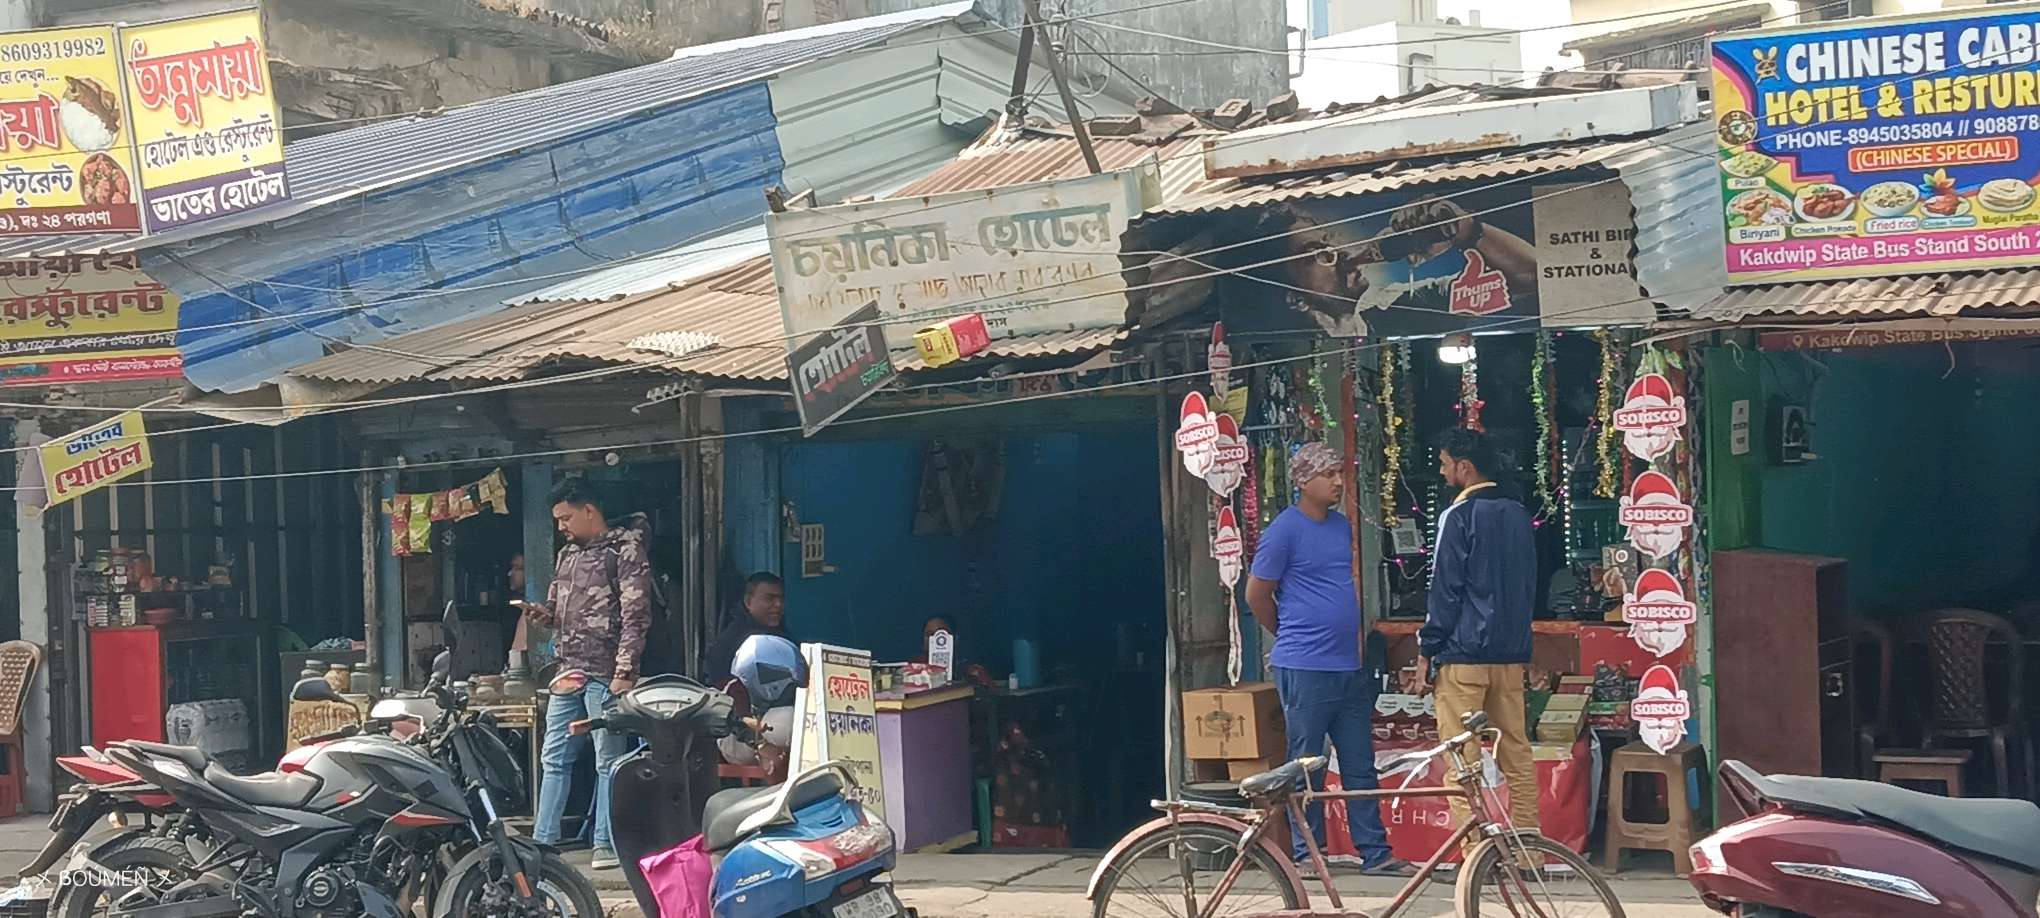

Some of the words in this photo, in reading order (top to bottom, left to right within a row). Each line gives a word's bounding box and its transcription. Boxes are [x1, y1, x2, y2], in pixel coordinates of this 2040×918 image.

[1, 37, 105, 62] 8609319982
[1786, 31, 1946, 83] CHINESE
[1765, 84, 1868, 126] HOTEL
[1877, 82, 1904, 118] &
[1913, 70, 2040, 115] RESTUR
[1776, 121, 1953, 149] PHONE-8945035804
[1974, 115, 2040, 134] 908878
[144, 133, 190, 169] হোটেল
[1856, 145, 1932, 170] (CHINESE
[1936, 140, 2011, 163] SPECIAL)
[151, 185, 216, 223] ভাতের
[220, 170, 286, 210] হোটেল
[42, 213, 61, 230] ২৪
[64, 211, 111, 230] পরগণা
[1871, 219, 1895, 231] Fried
[1898, 217, 1917, 229] rice
[788, 219, 952, 284] চয়নিকা
[977, 204, 1113, 253] হোটেল
[1550, 231, 1600, 245] SATHI
[1590, 248, 1602, 259] &
[1740, 244, 1817, 267] Kakdwip
[1821, 240, 1868, 262] State
[1873, 239, 1909, 259] Bus
[1914, 235, 1969, 257] Stand
[1974, 231, 2029, 253] South
[1543, 263, 1632, 279] STATIONA
[1453, 278, 1502, 302] Thums
[1809, 331, 1879, 348] Kakdwip
[1883, 330, 1926, 344] State
[1618, 409, 1681, 426] SOBISCO
[1179, 424, 1215, 443] SOBISCO
[52, 441, 143, 494] হোটেল
[1624, 508, 1688, 522] SOBISCO
[1628, 606, 1691, 620] SOBISCO
[1634, 702, 1685, 716] SOBISCO
